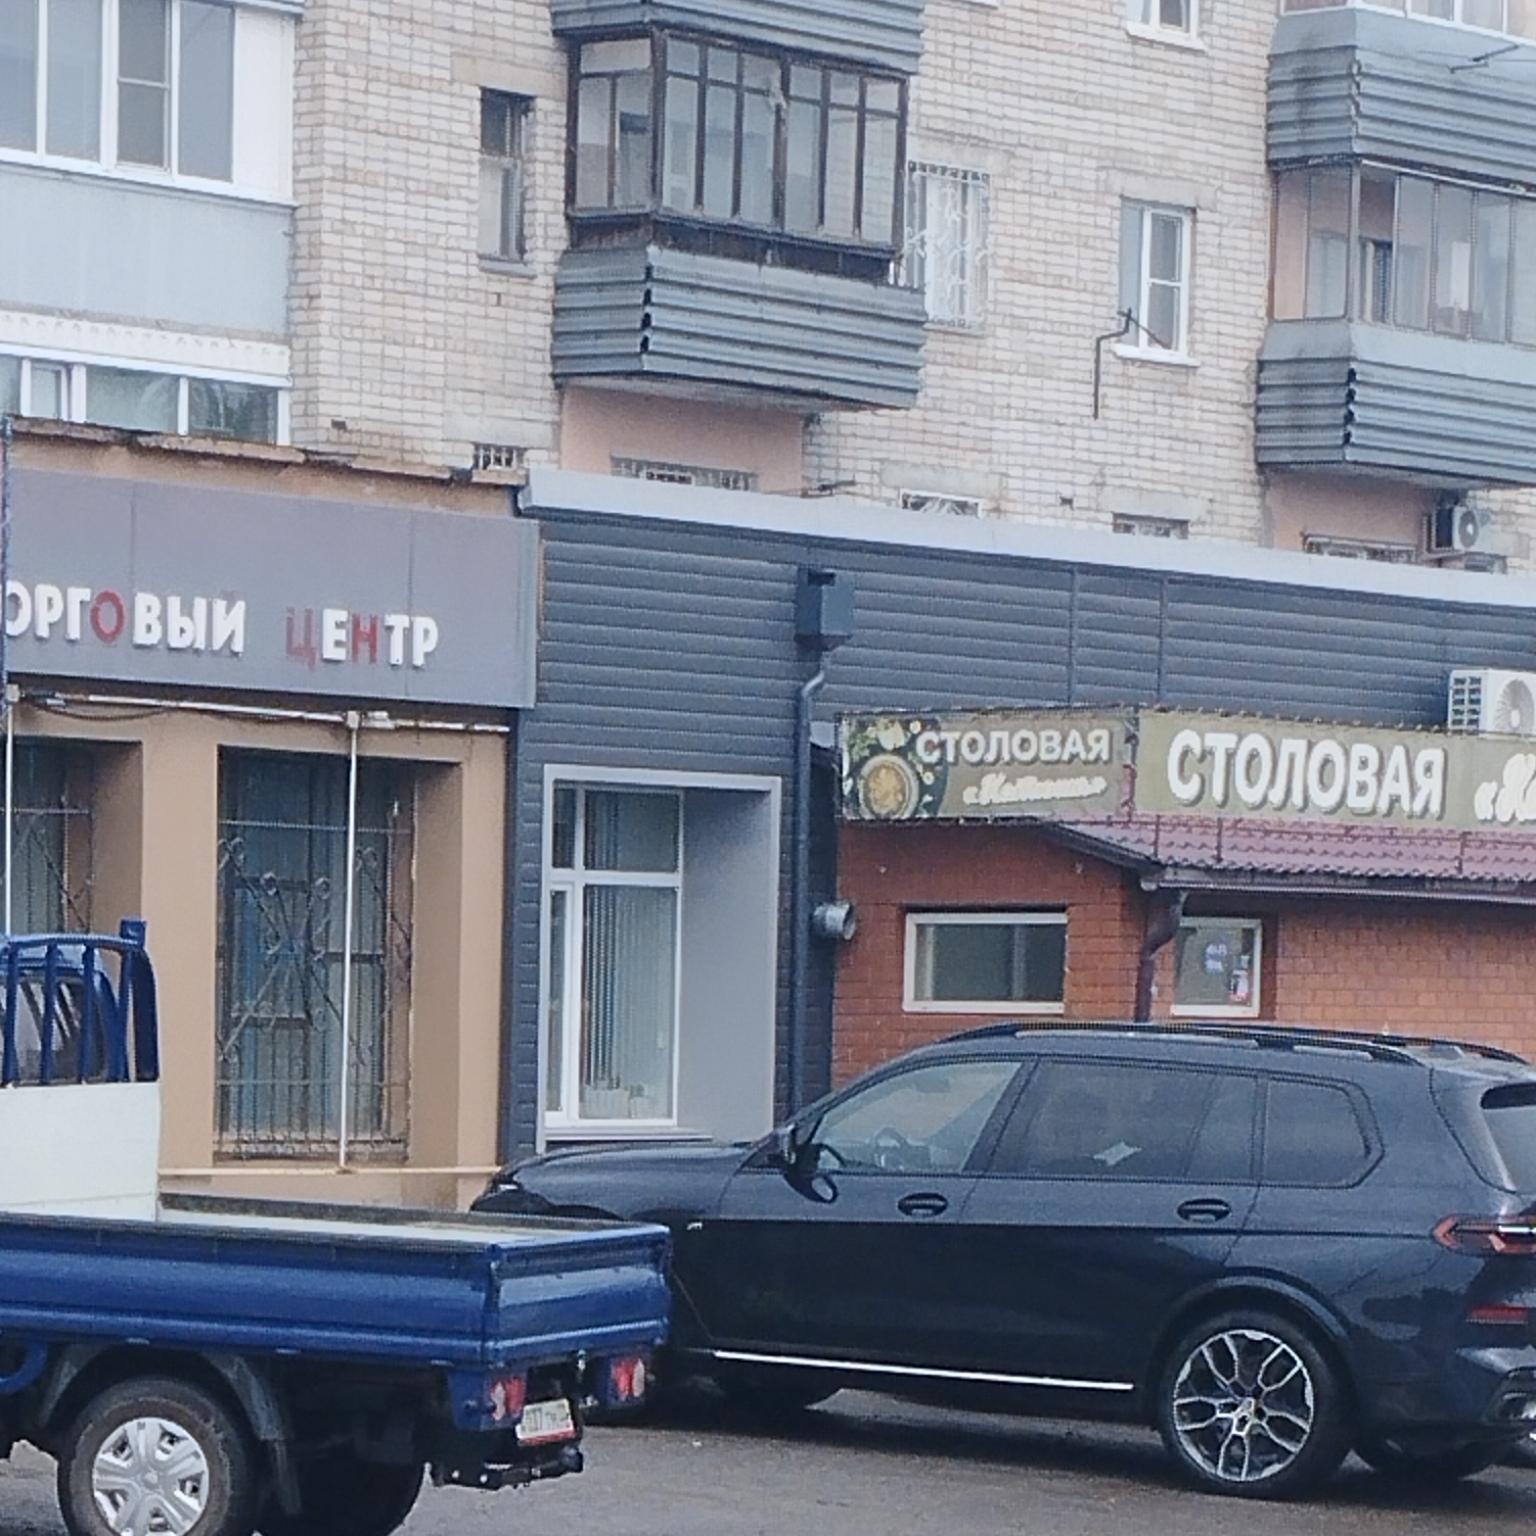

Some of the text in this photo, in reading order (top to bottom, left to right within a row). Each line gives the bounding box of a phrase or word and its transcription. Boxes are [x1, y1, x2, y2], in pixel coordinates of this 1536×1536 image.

[286, 606, 439, 669] ЦЕНТР
[916, 728, 1109, 765] СТОЛОВАЯ
[1166, 728, 1446, 816] СТОЛОВАЯ
